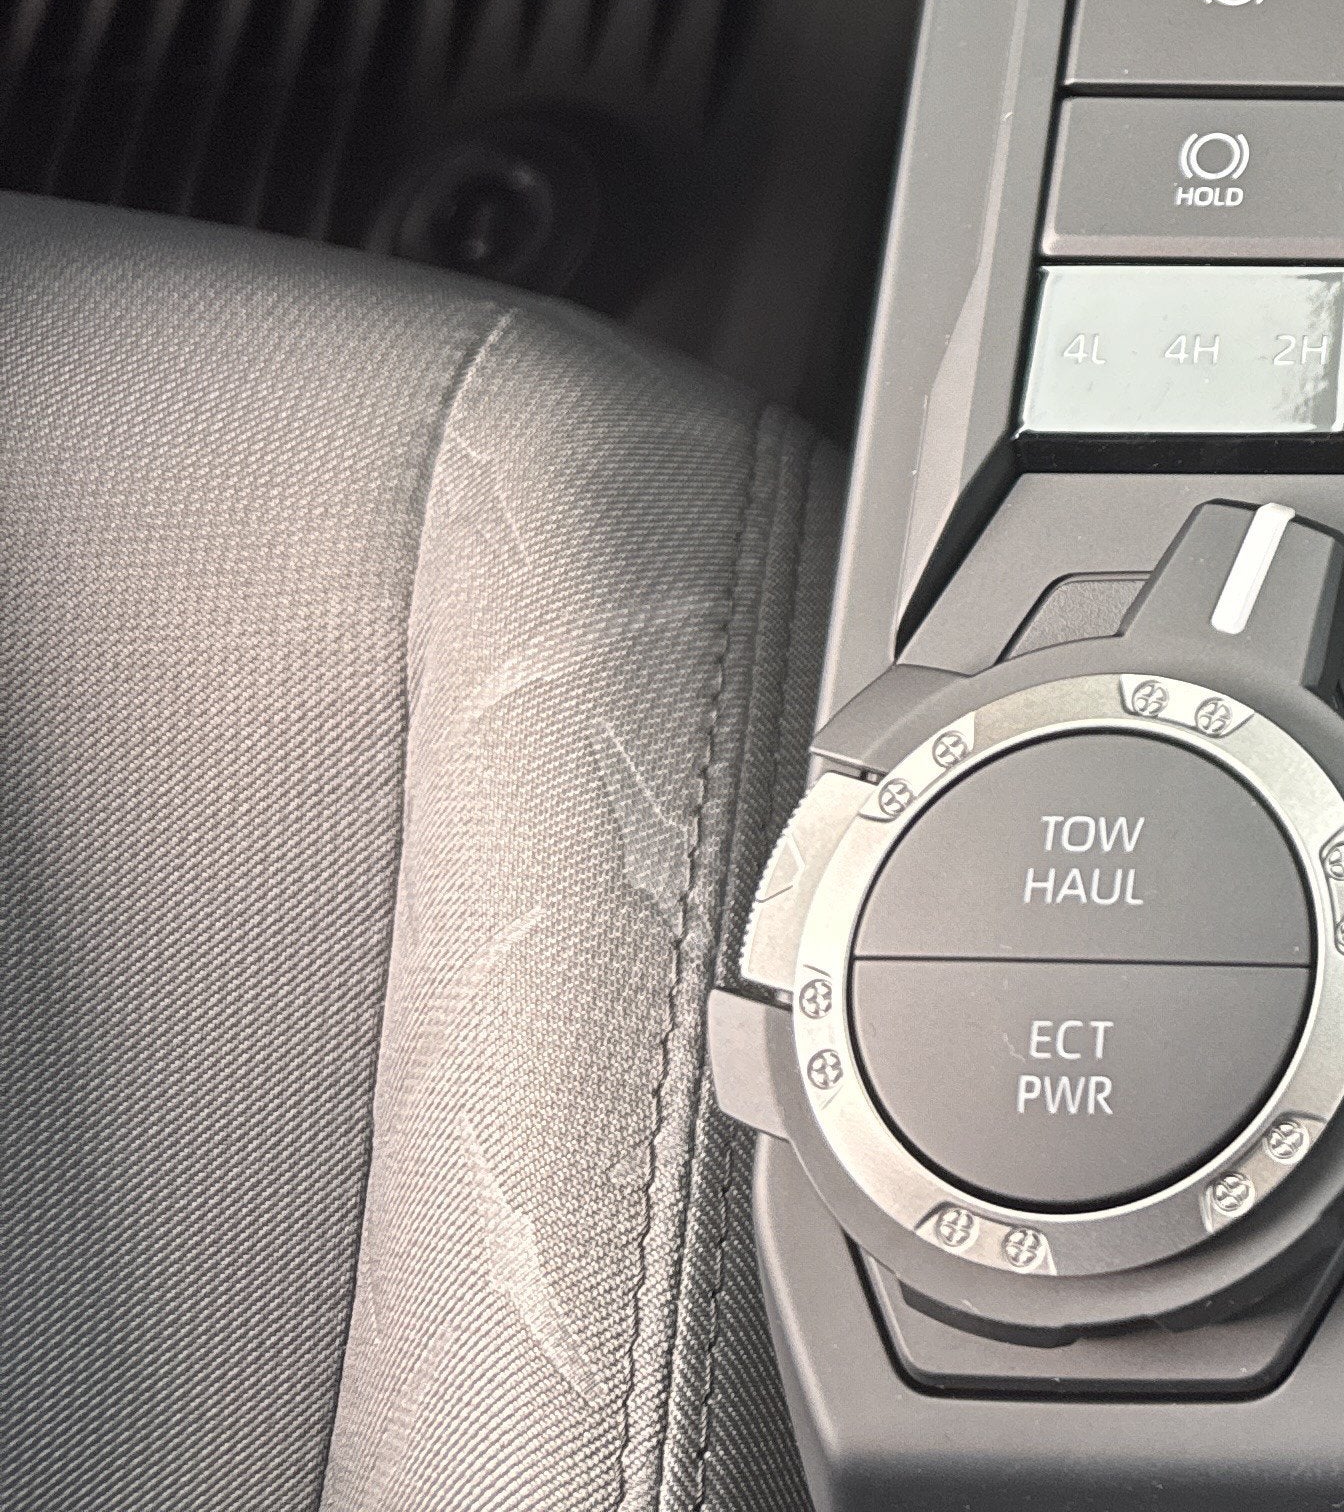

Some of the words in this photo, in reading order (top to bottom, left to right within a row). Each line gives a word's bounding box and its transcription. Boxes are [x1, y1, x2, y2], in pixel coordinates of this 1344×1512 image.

[1176, 186, 1244, 207] HOLD
[1062, 332, 1105, 365] 4L
[1164, 332, 1221, 365] 4H
[1272, 332, 1330, 365] 2H
[1041, 814, 1144, 854] TOW
[1023, 867, 1145, 906] HAUL
[1029, 1019, 1114, 1061] ECT
[1016, 1076, 1114, 1116] PWR
